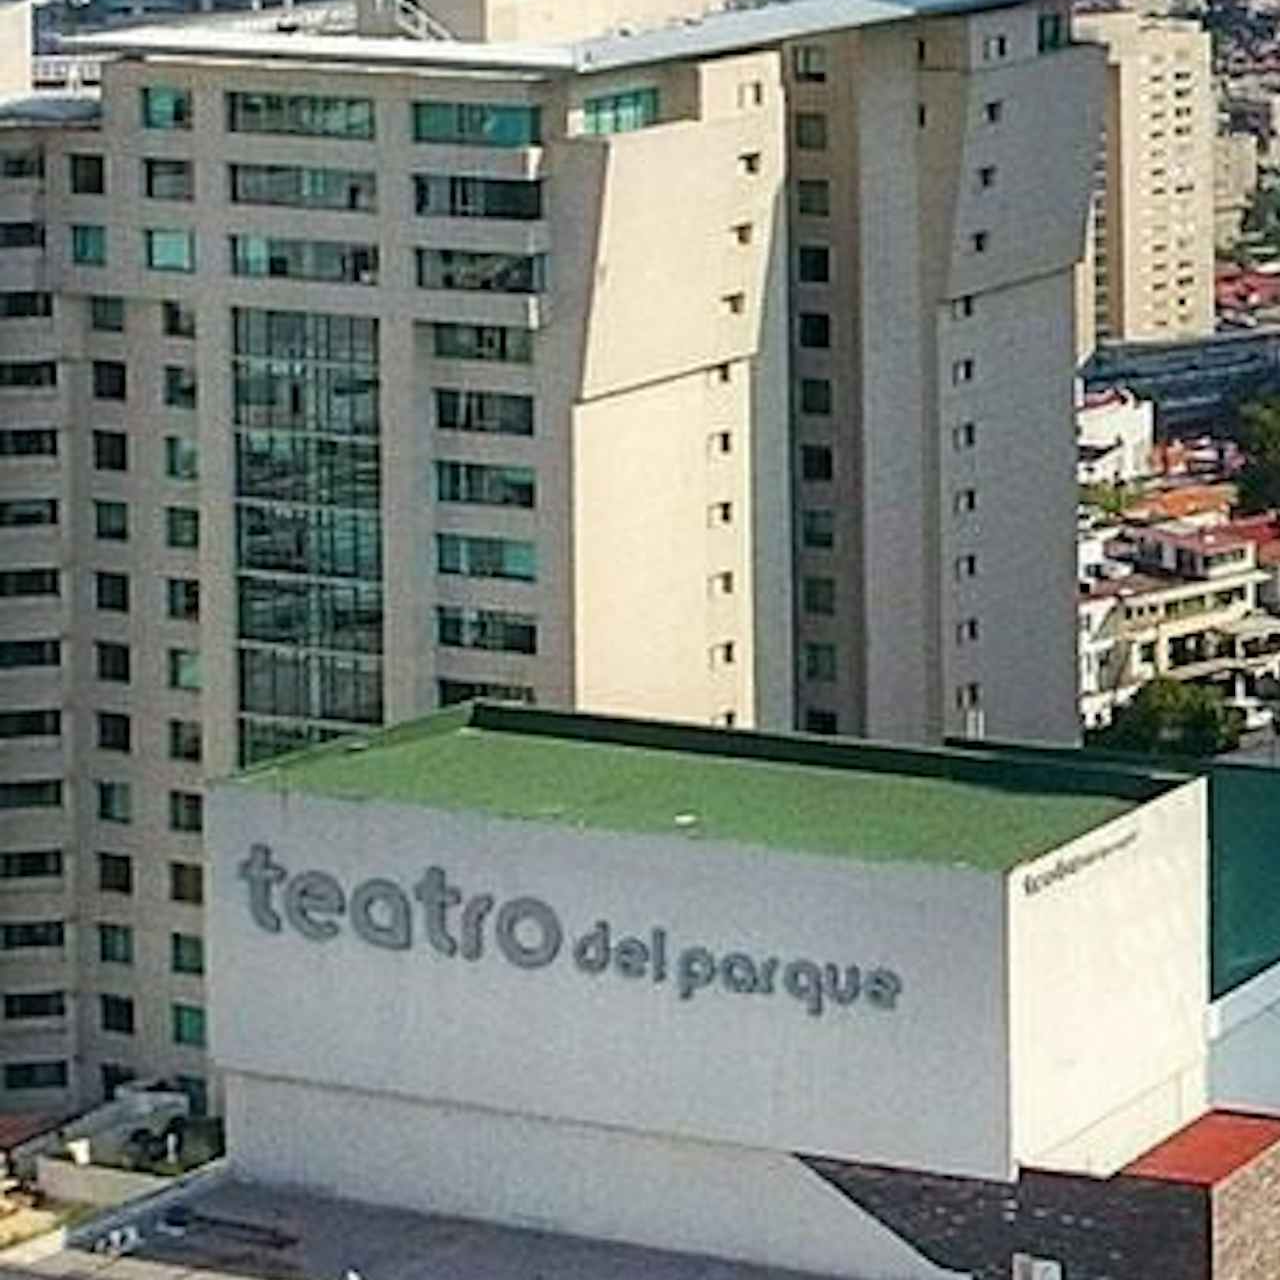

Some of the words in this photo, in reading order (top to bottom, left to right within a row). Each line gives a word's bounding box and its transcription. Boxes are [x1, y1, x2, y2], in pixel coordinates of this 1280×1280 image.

[238, 843, 563, 969] teatro
[573, 919, 667, 984] del
[677, 946, 903, 1017] parque
